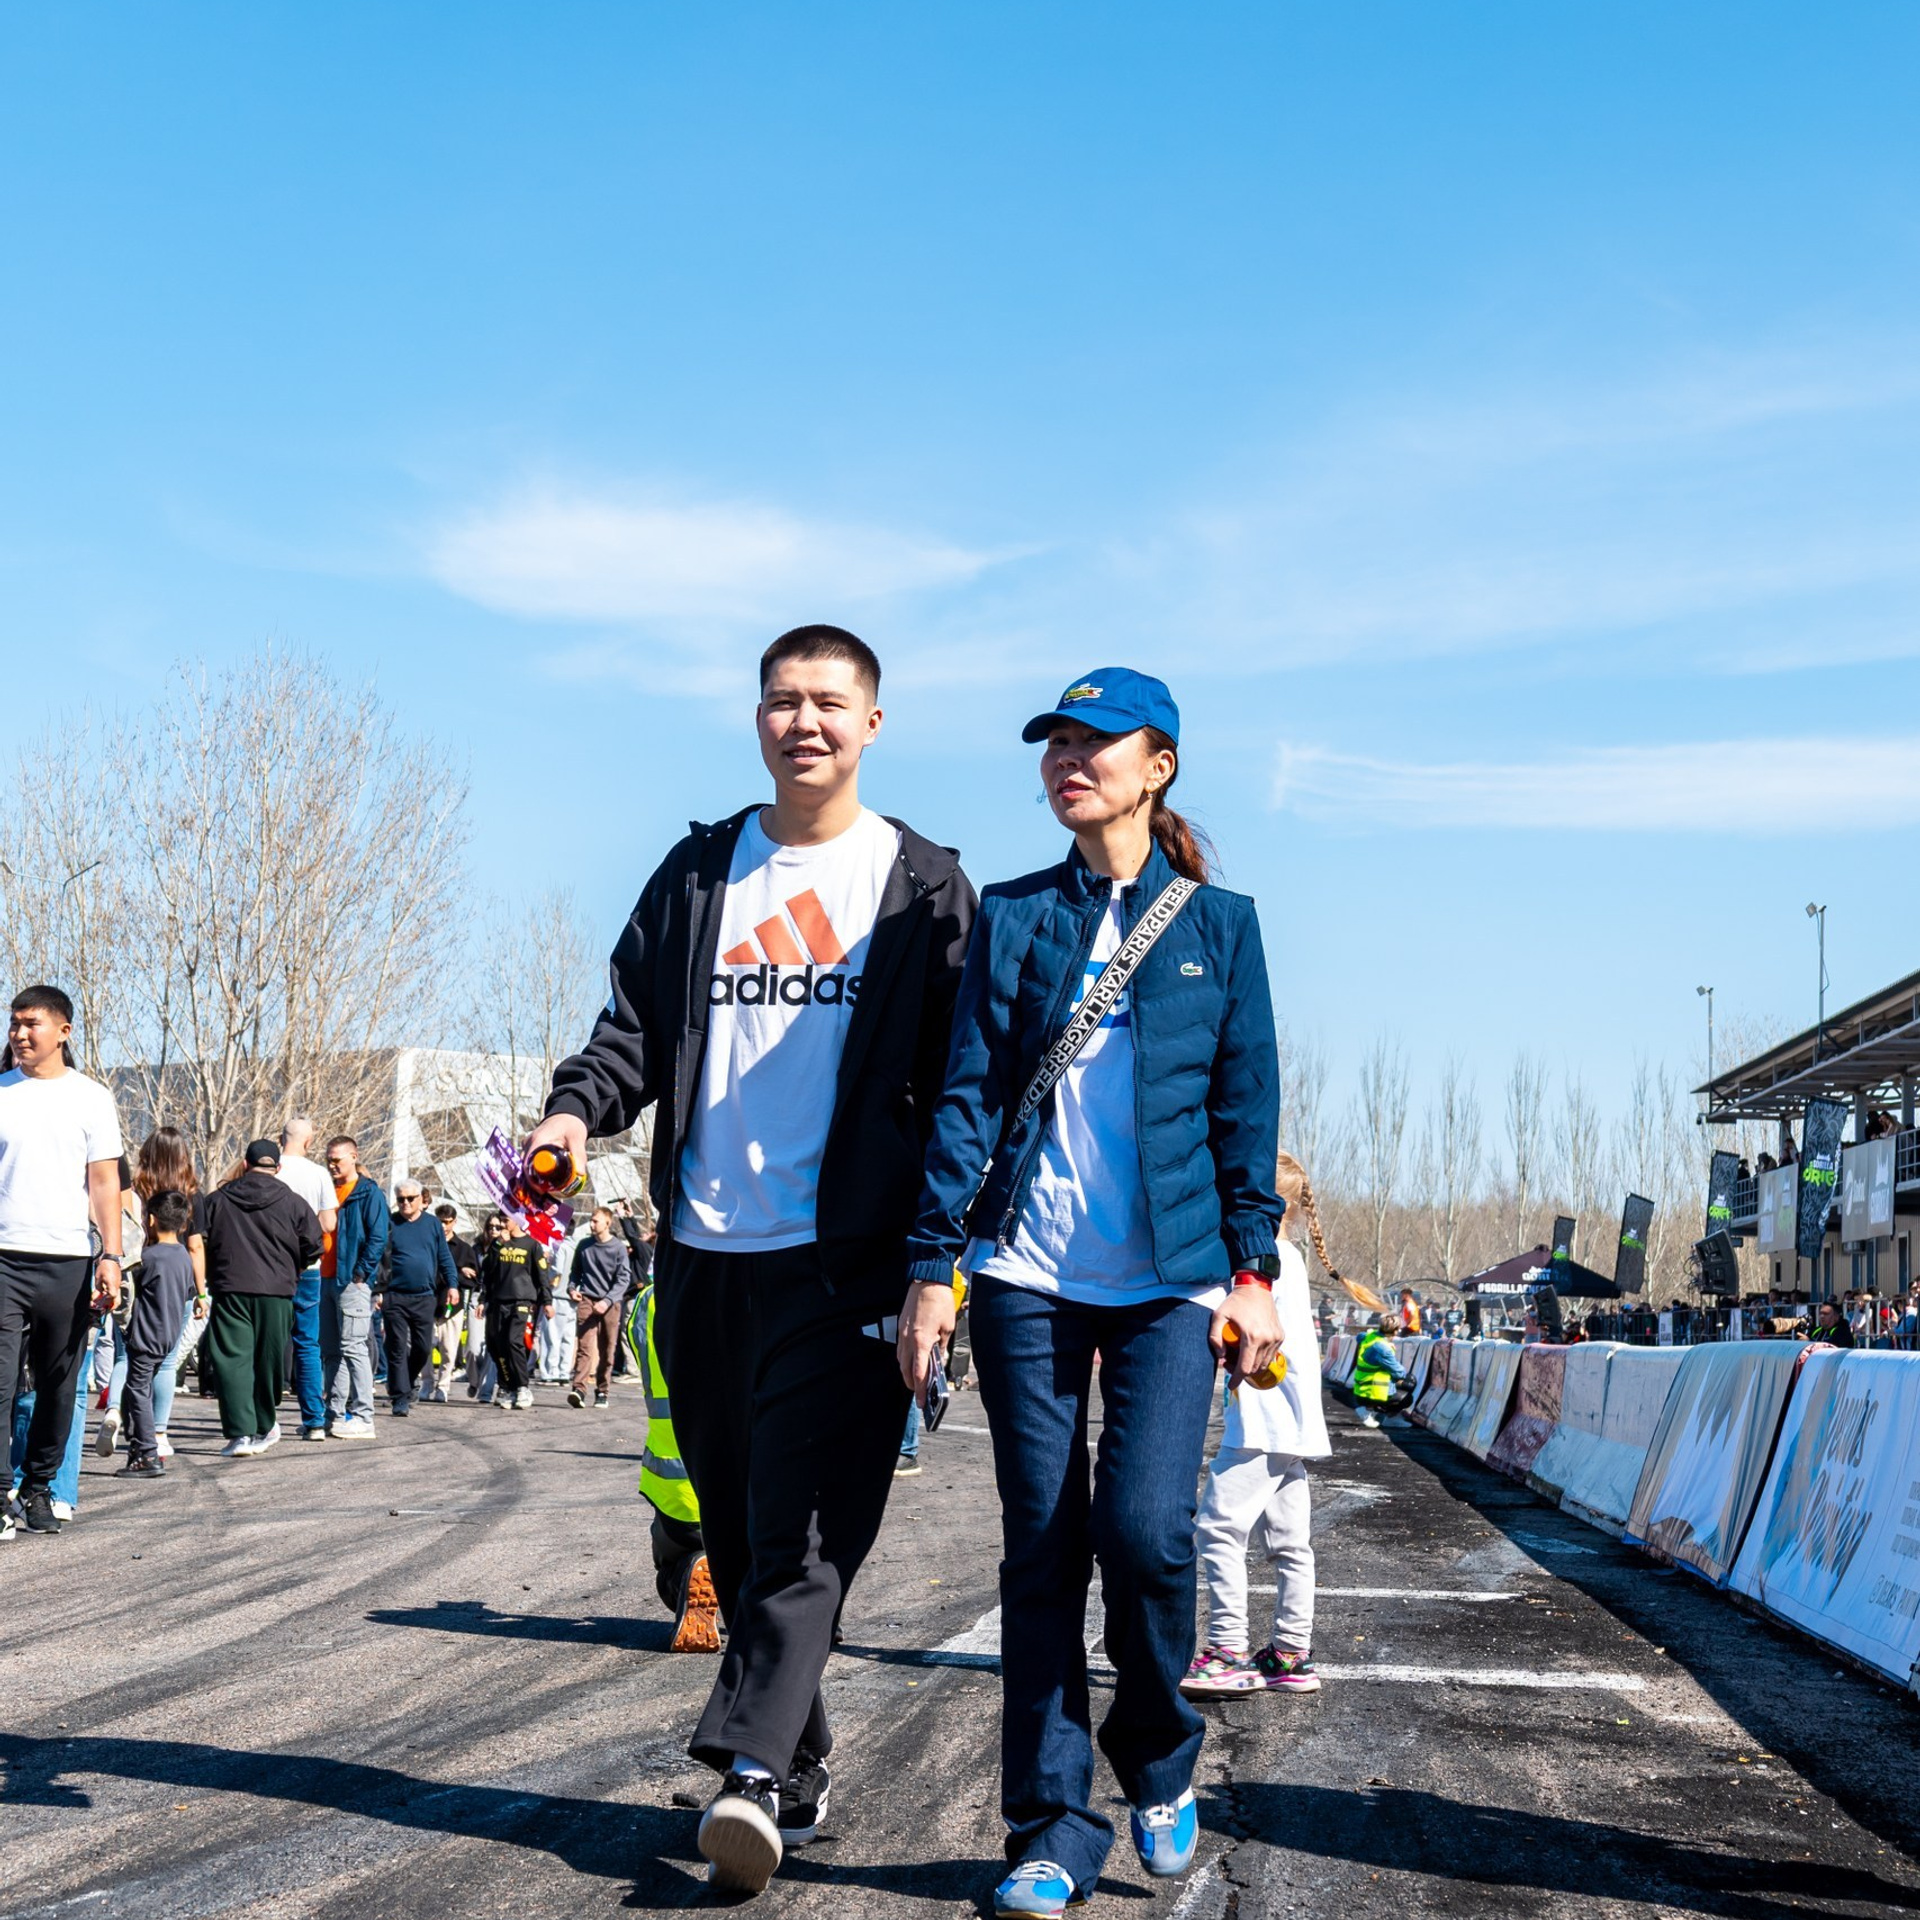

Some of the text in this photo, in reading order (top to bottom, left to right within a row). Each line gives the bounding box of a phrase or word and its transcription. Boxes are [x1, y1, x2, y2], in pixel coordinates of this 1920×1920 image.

[1121, 916, 1163, 963] PARIS
[709, 963, 864, 1007] adidas
[1088, 966, 1126, 1010] KARL
[1027, 1009, 1097, 1102] LAGERFELD
